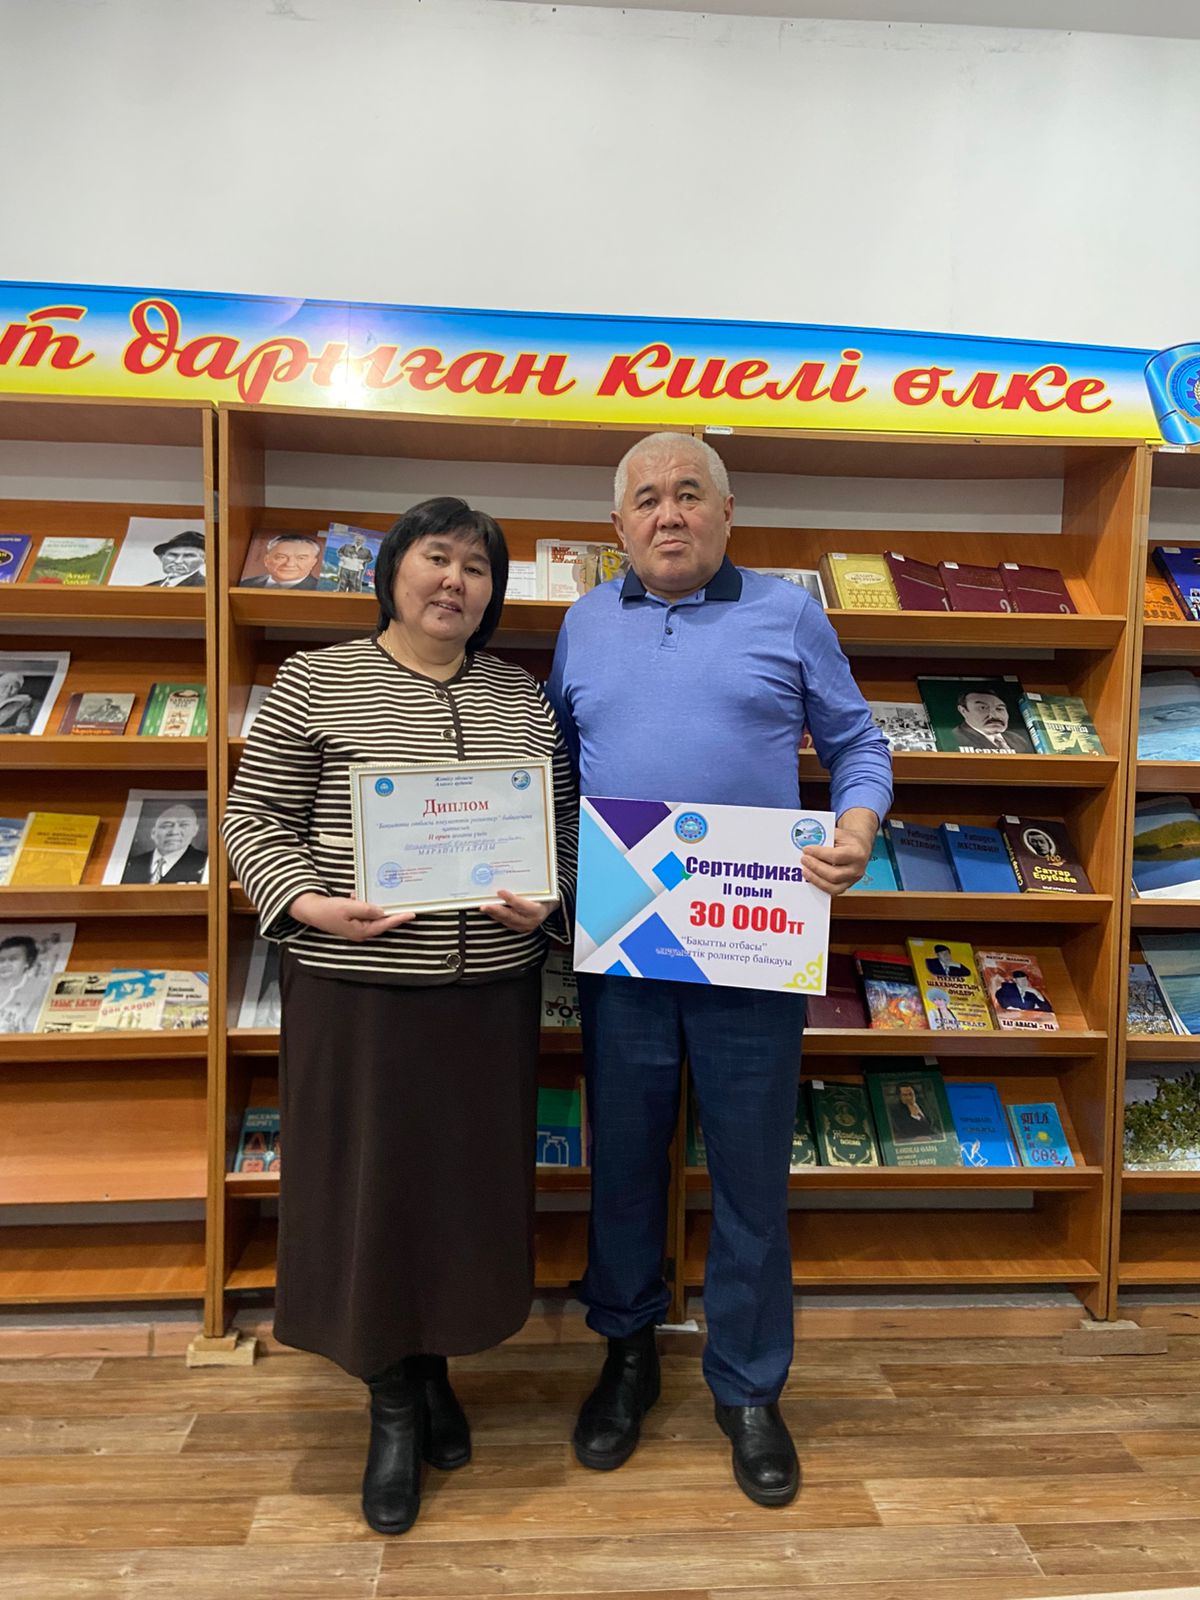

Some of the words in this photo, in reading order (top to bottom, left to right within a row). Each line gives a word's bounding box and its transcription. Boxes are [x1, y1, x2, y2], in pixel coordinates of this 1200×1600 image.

[122, 299, 577, 404] дарыған
[596, 341, 867, 404] киелі
[893, 364, 1113, 414] өлке
[423, 799, 489, 817] Диплом
[685, 855, 812, 883] Сертифика
[1032, 871, 1078, 884] Ерубаев
[1034, 866, 1071, 877] Саттар
[722, 882, 733, 896] II
[735, 885, 774, 899] орын
[689, 900, 726, 928] 30
[707, 951, 750, 964] роликтер
